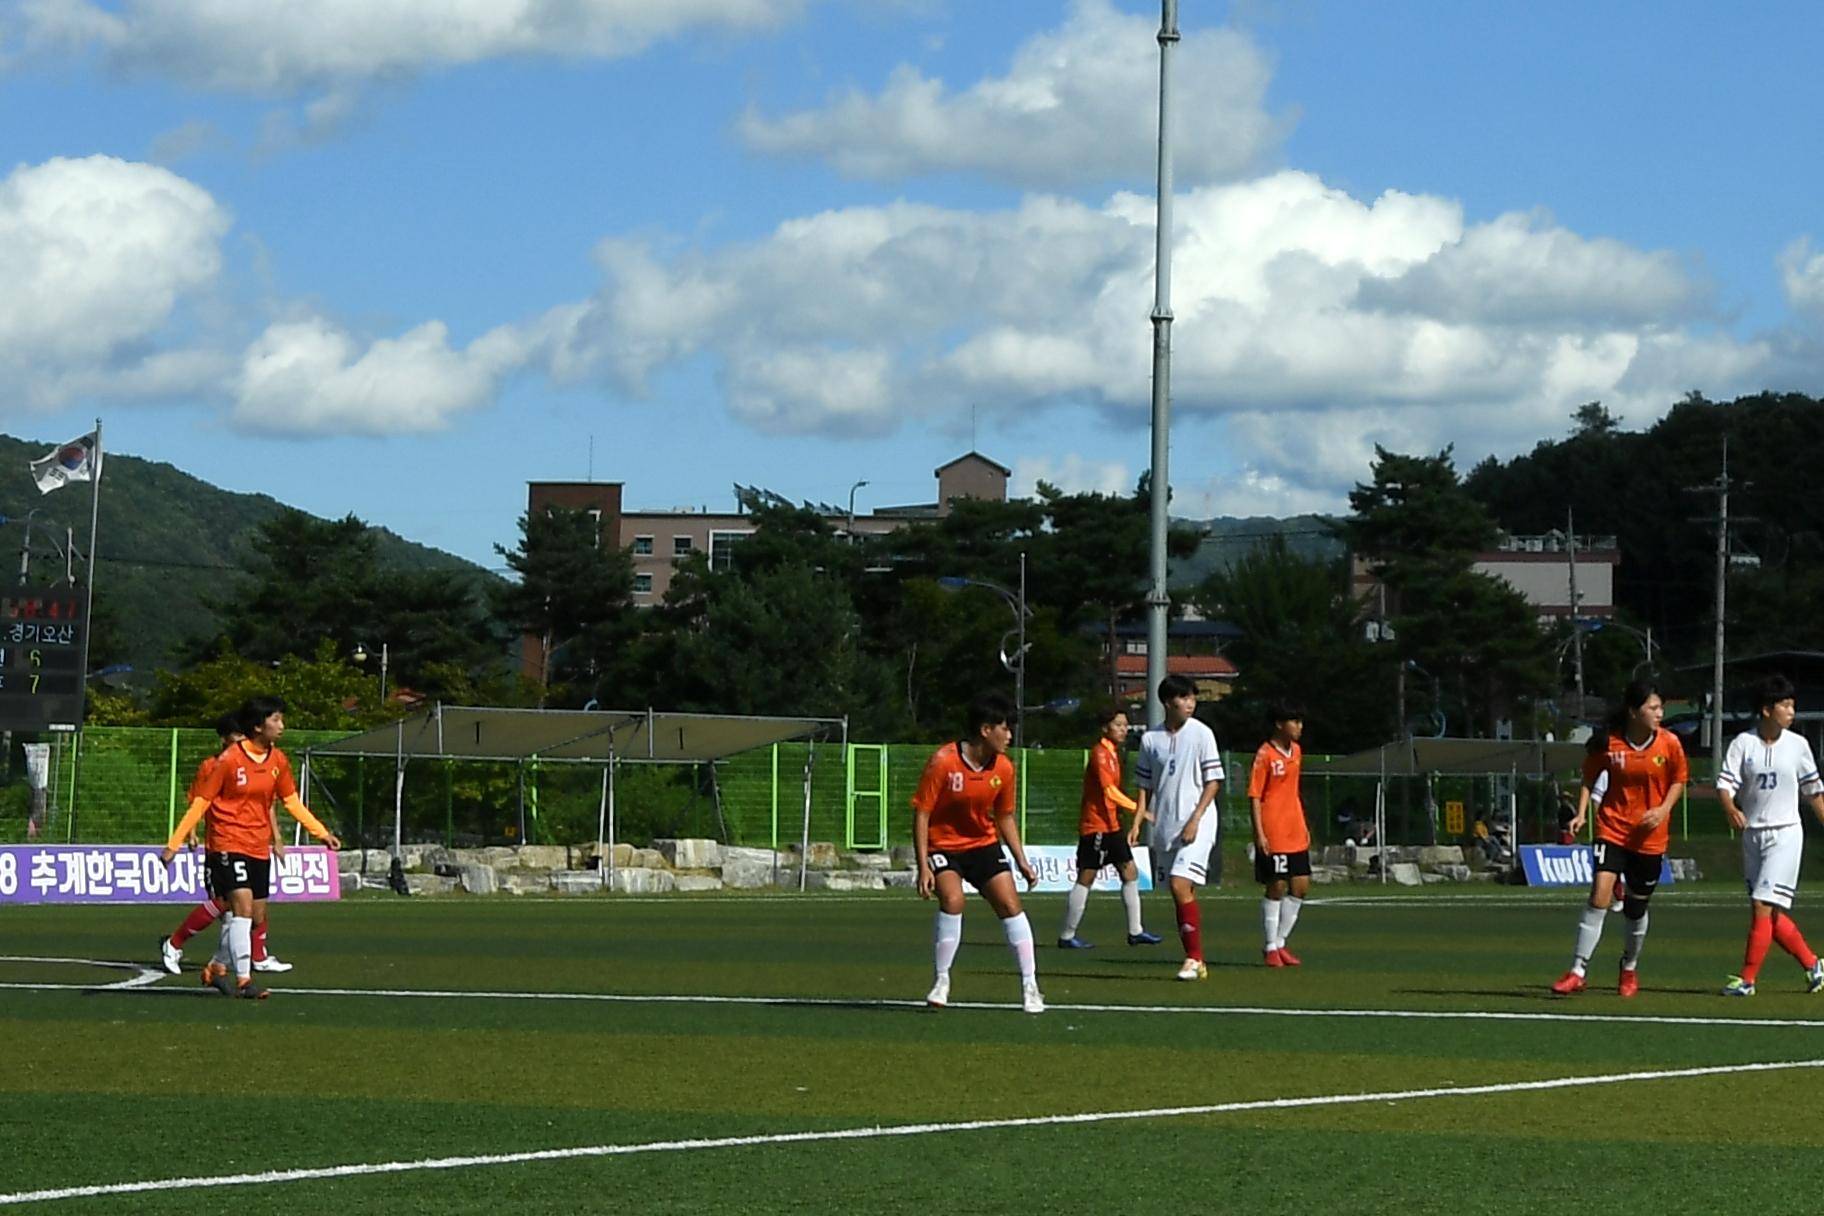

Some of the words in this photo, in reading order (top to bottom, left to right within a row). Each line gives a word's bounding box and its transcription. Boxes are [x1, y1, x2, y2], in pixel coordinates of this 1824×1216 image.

[236, 767, 248, 786] 5
[1271, 760, 1286, 776] 12
[1756, 771, 1778, 790] 23
[234, 861, 248, 882] 5
[1273, 854, 1289, 874] 12
